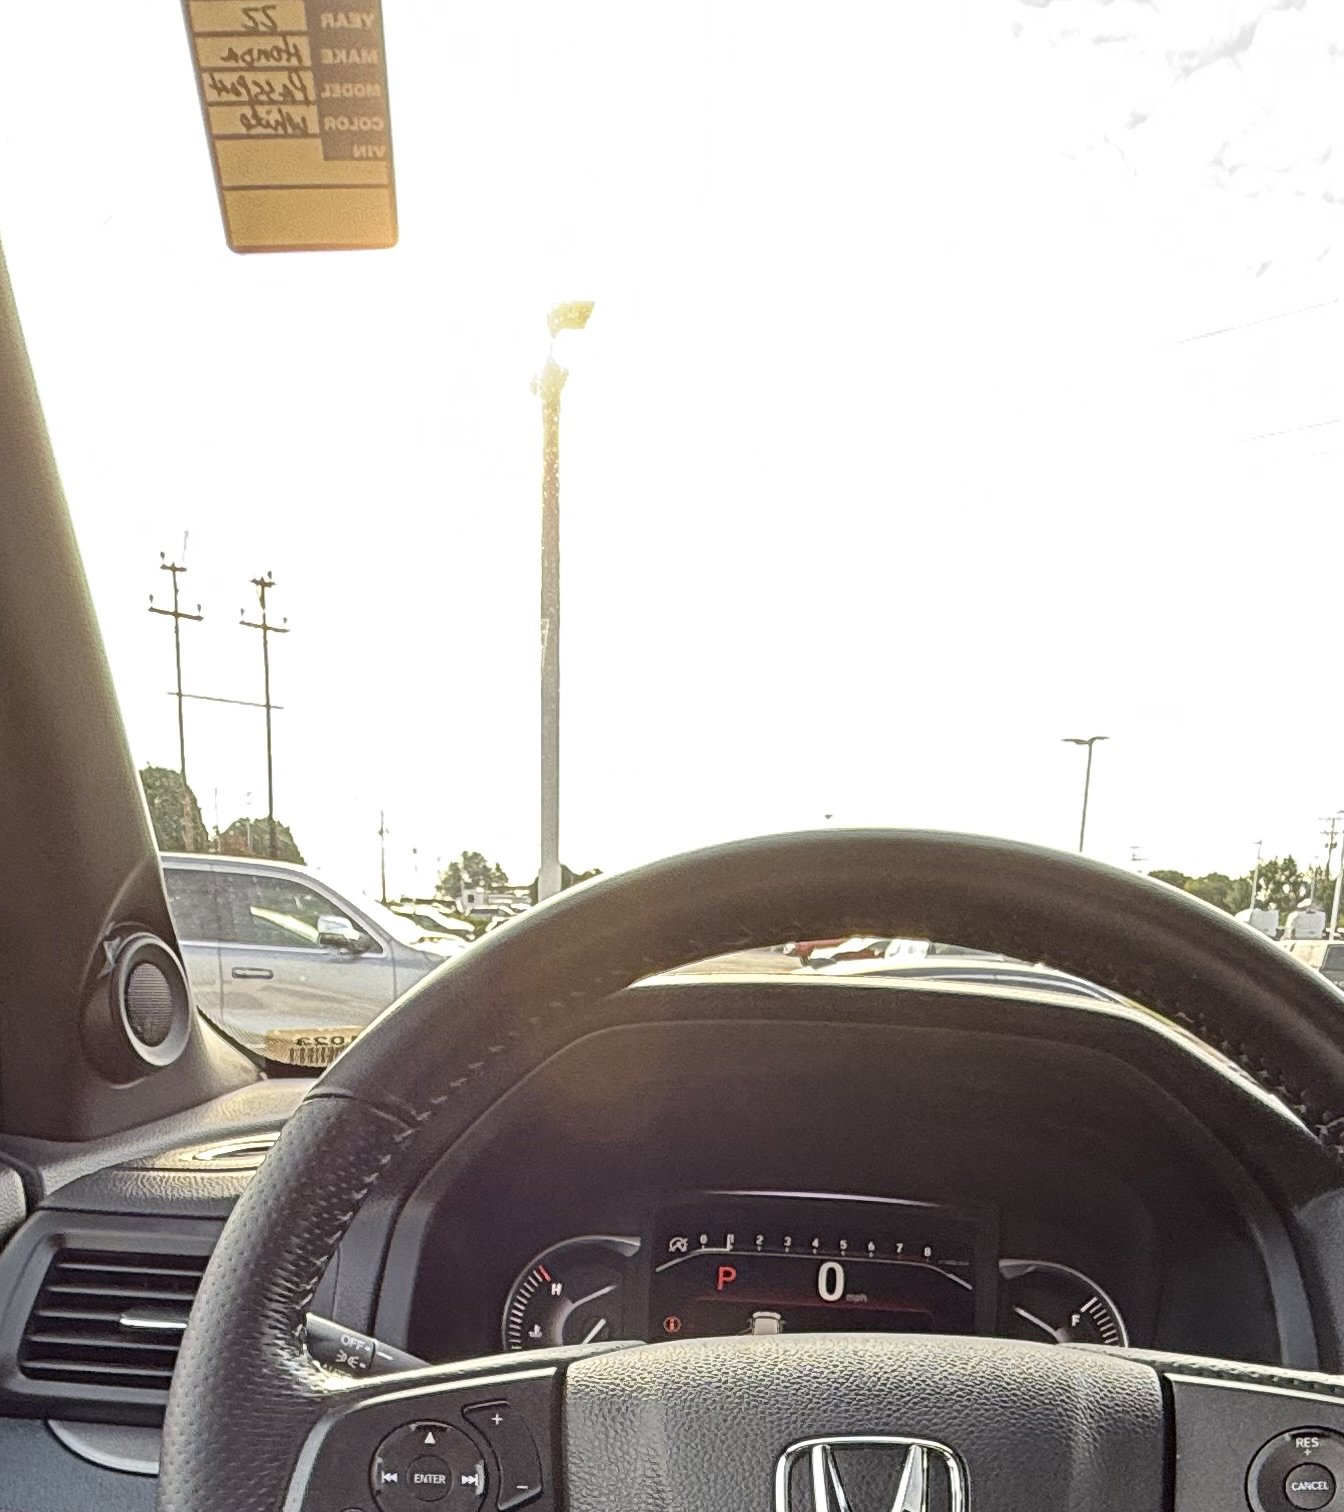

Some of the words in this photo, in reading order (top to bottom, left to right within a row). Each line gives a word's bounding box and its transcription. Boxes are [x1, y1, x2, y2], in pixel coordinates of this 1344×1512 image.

[699, 1233, 707, 1244] 0
[756, 1234, 764, 1245] 2
[784, 1236, 792, 1247] 3
[812, 1237, 819, 1248] 4
[839, 1239, 847, 1250] 5
[868, 1241, 875, 1252] 6
[896, 1242, 904, 1253] 7
[924, 1246, 931, 1257] 8
[716, 1266, 737, 1291] P
[817, 1261, 845, 1302] 0
[551, 1283, 562, 1296] H
[1071, 1314, 1081, 1326] F
[1295, 1437, 1320, 1448] RES
[413, 1473, 446, 1485] ENTER
[1291, 1481, 1330, 1492] CANCEL
